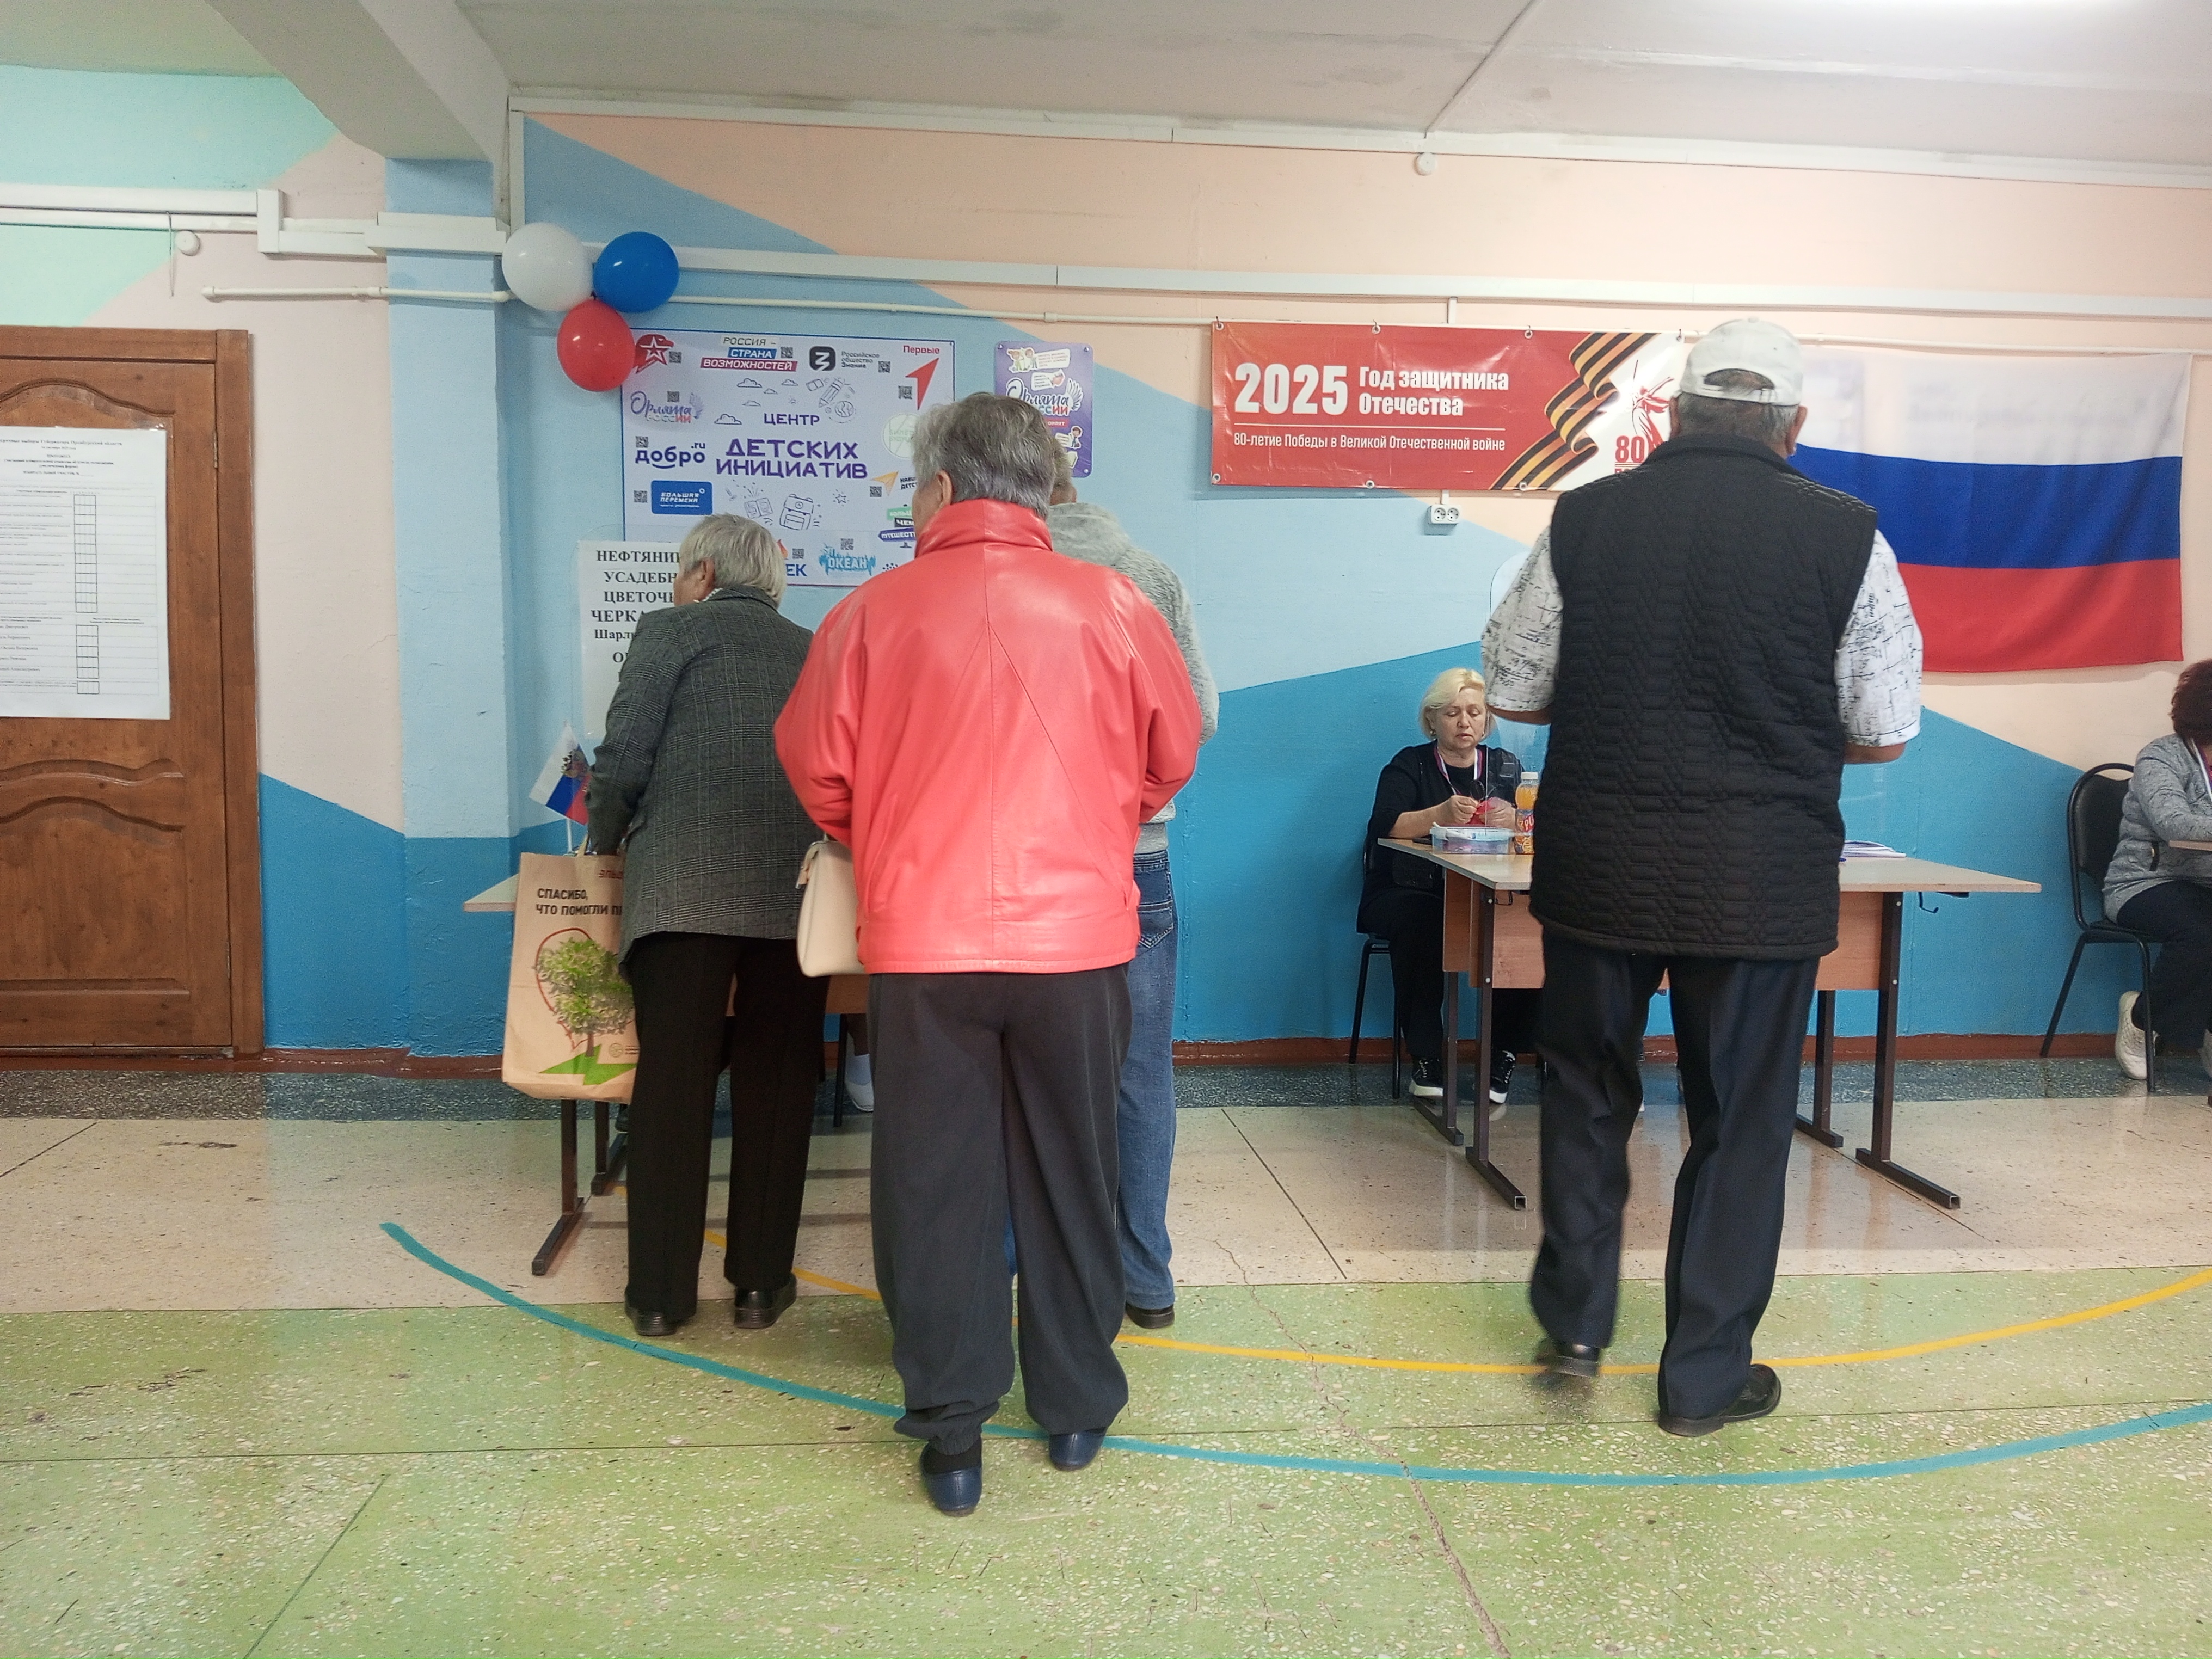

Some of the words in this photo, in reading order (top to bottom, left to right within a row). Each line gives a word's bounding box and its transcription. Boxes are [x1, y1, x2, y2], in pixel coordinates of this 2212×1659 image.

[723, 337, 766, 346] РОССИЯ
[730, 348, 772, 359] СТРАНА
[902, 345, 941, 355] Первые
[703, 358, 793, 371] ВОЗМОЖНОСТЕЙ
[1234, 362, 1348, 415] 2025
[1359, 366, 1396, 390] Год
[1398, 371, 1509, 392] защитника
[1359, 392, 1464, 416] Отечества
[763, 413, 820, 426] ЦЕНТР
[1234, 433, 1282, 446] 80-летие
[1285, 434, 1328, 449] Победы
[1331, 437, 1337, 448] в
[1340, 435, 1386, 448] Великой
[1389, 435, 1470, 450] Отечественной
[1472, 437, 1506, 451] войне
[725, 438, 859, 460] ДЕТСКИХ
[1614, 435, 1645, 463] 80
[635, 446, 706, 468] добро
[716, 458, 868, 479] ИНИЦИАТИВ
[828, 557, 868, 569] ОКЕАН
[537, 888, 588, 900] СПАСИБО,
[536, 904, 557, 915] ЧТО
[561, 905, 609, 916] ПОМОГЛИ
